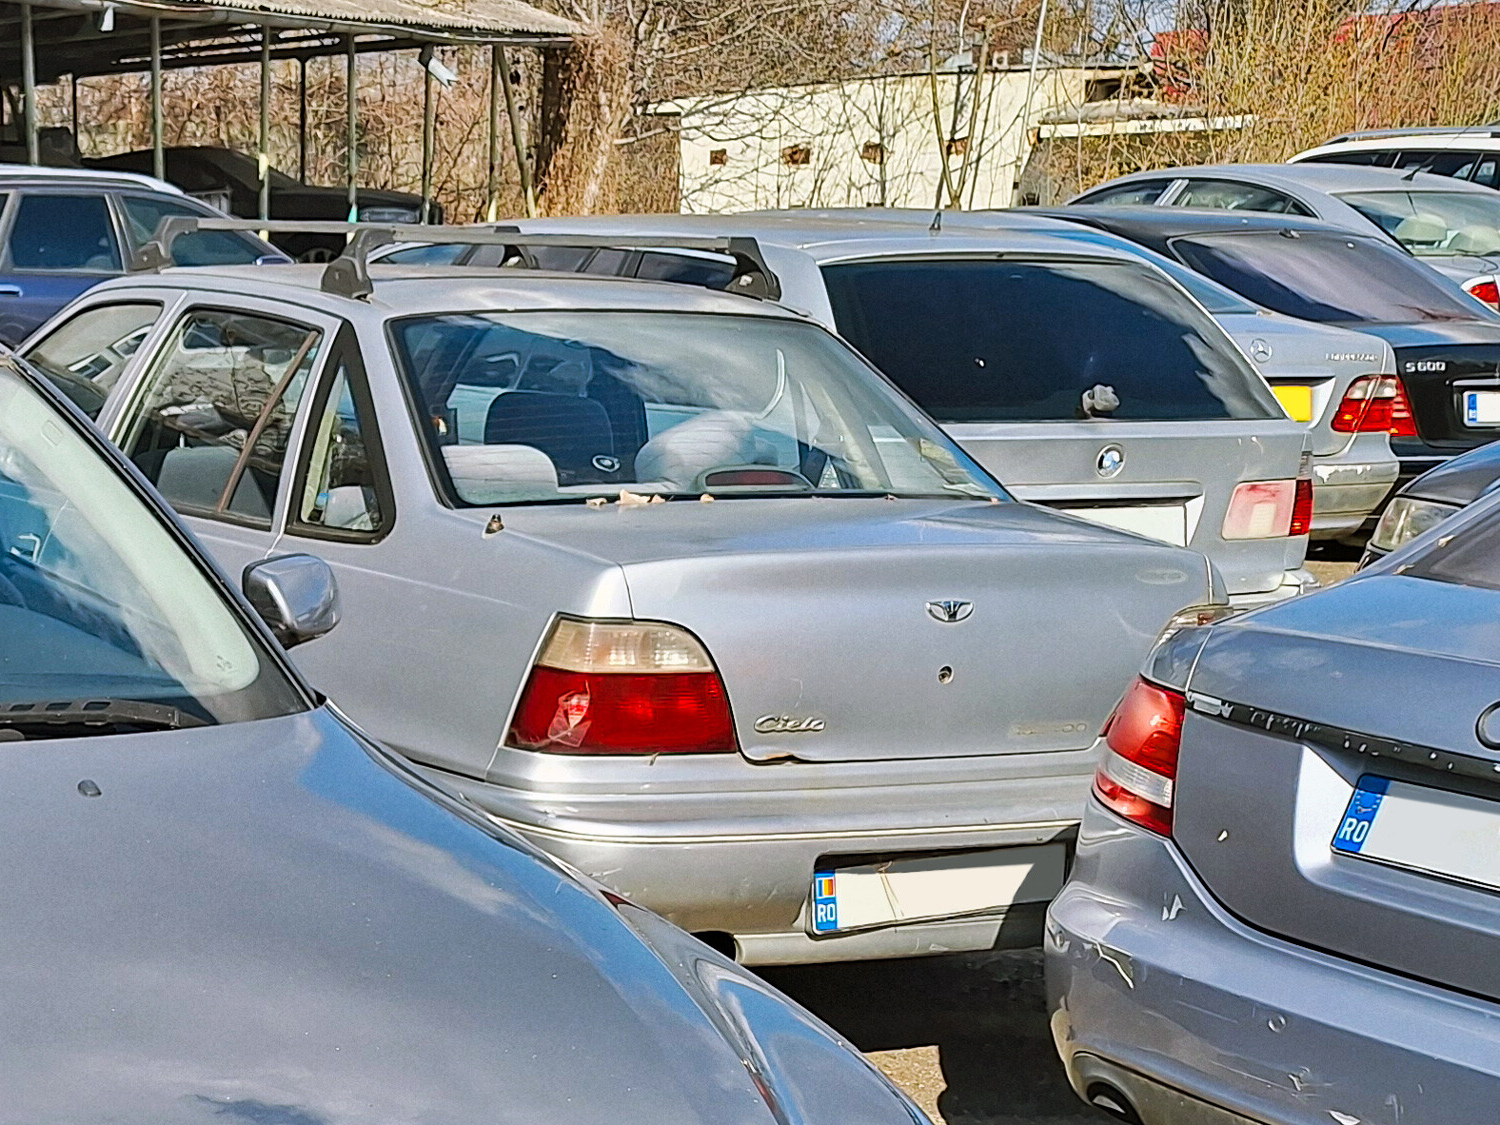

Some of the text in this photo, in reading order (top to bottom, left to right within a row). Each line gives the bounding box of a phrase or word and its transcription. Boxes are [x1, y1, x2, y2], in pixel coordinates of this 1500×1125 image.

[754, 714, 826, 733] Cielo
[1338, 816, 1370, 844] RO
[817, 903, 836, 923] RO
